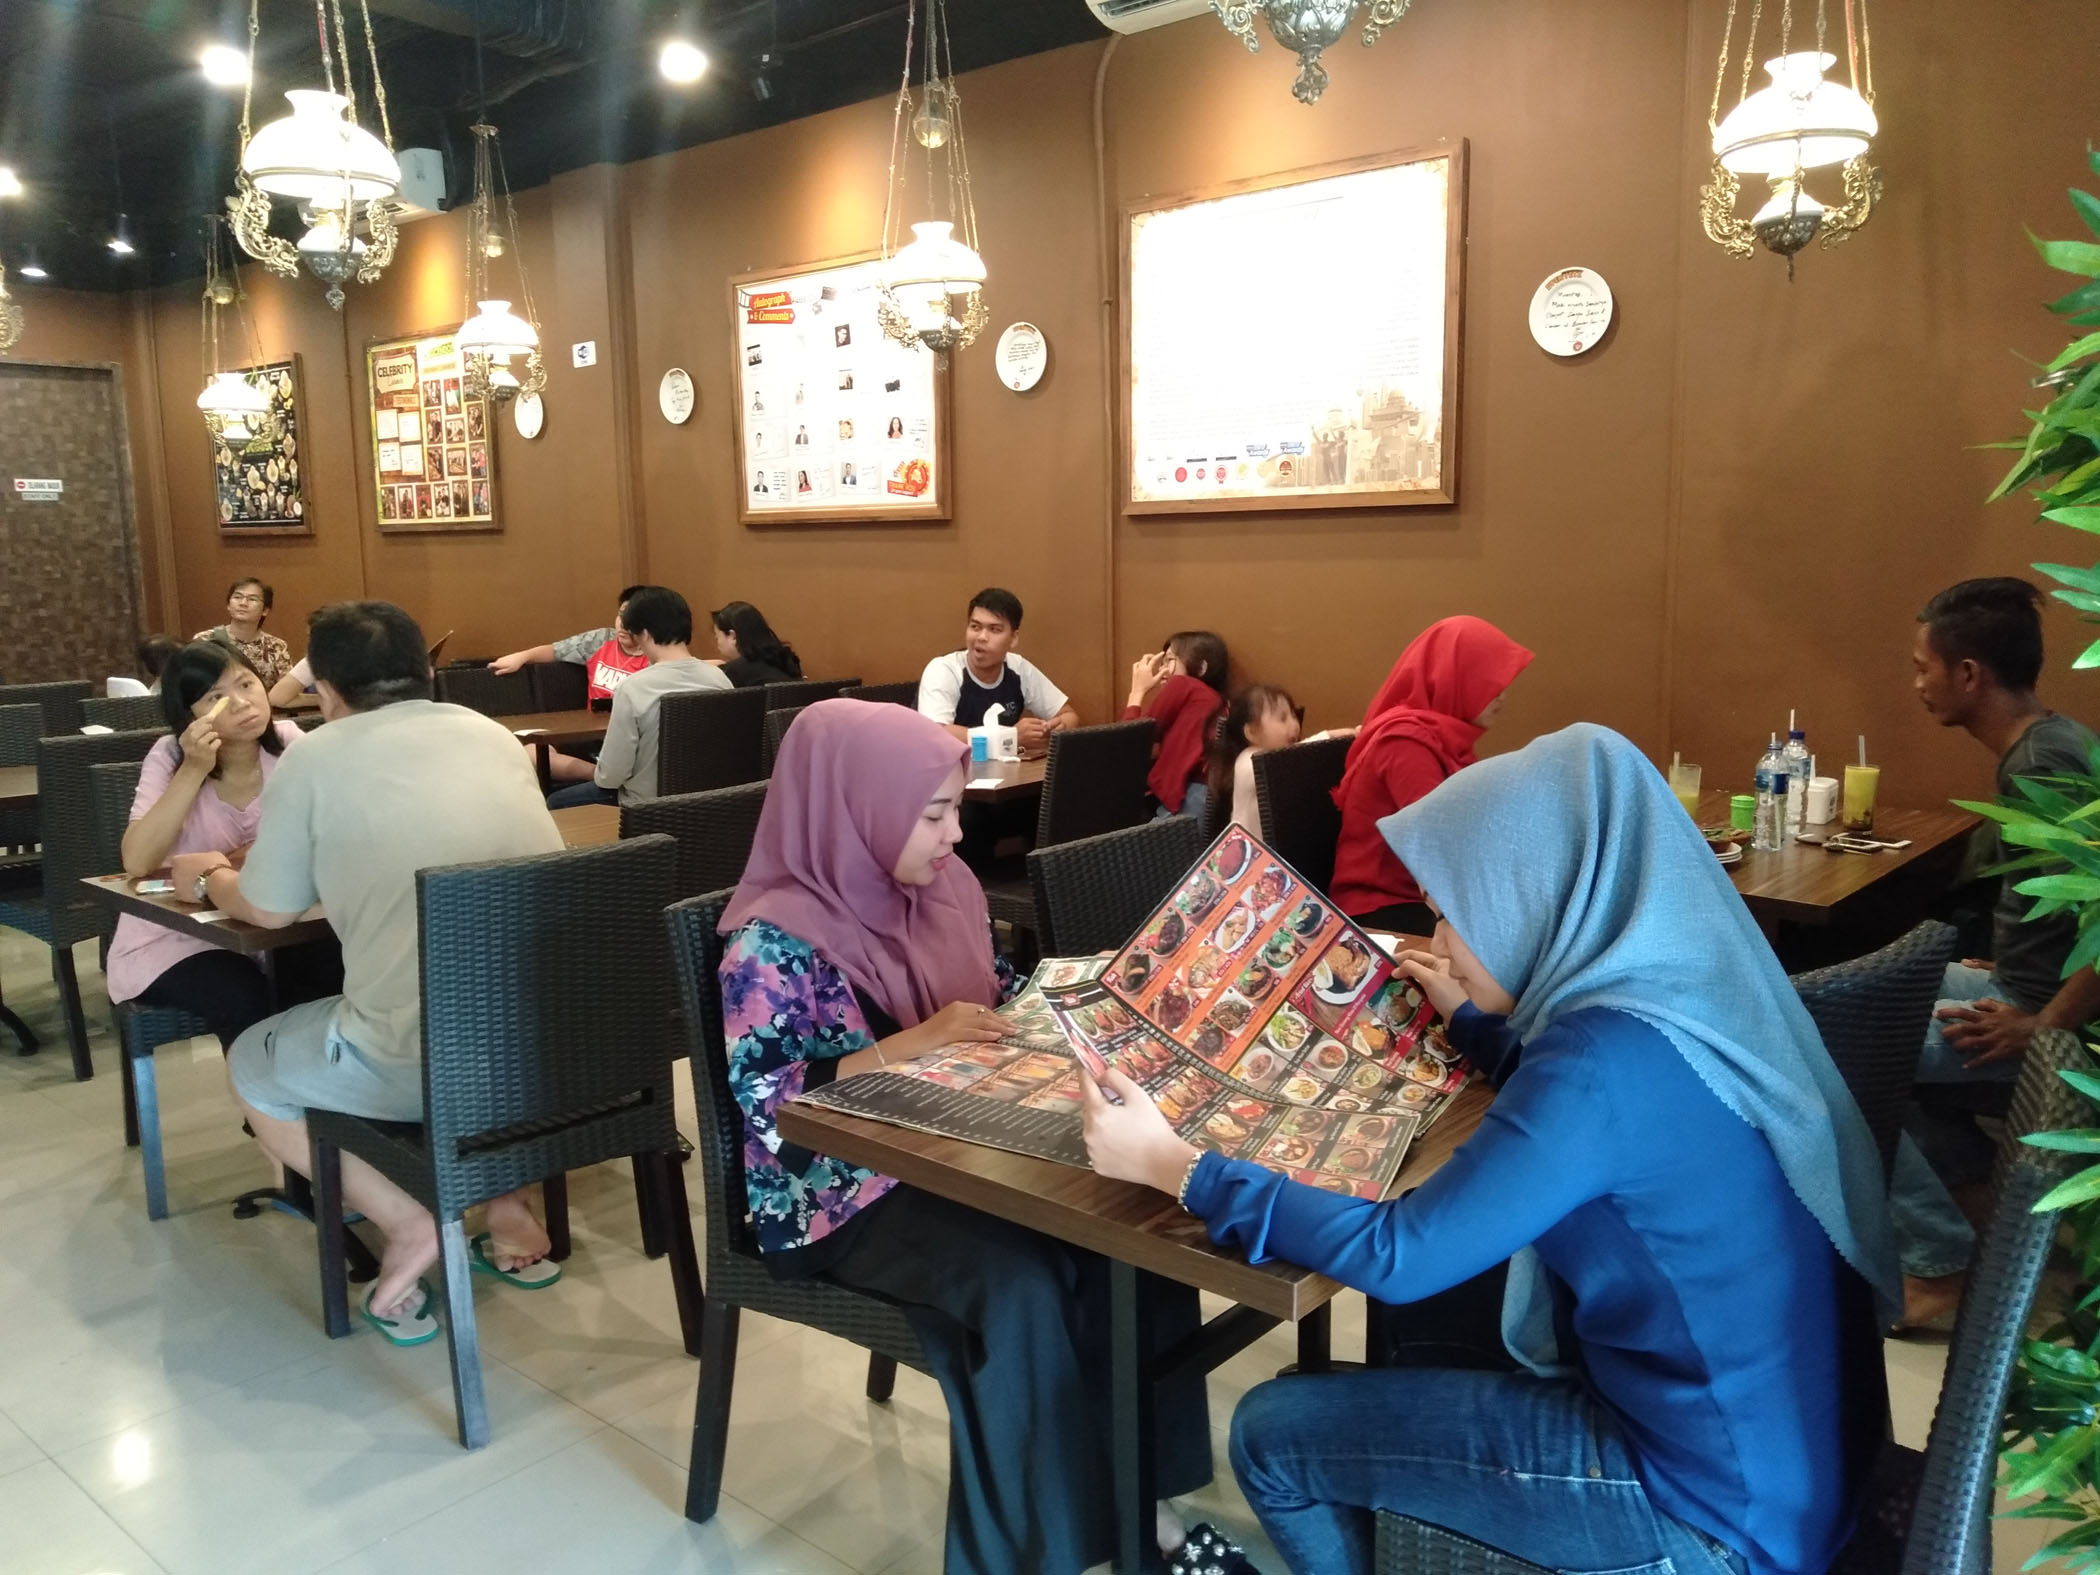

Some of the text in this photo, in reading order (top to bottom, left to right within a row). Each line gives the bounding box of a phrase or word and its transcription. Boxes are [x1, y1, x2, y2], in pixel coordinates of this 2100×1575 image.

[759, 310, 790, 321] Comments
[377, 362, 413, 378] CELEBRITY
[594, 662, 631, 691] MAR
